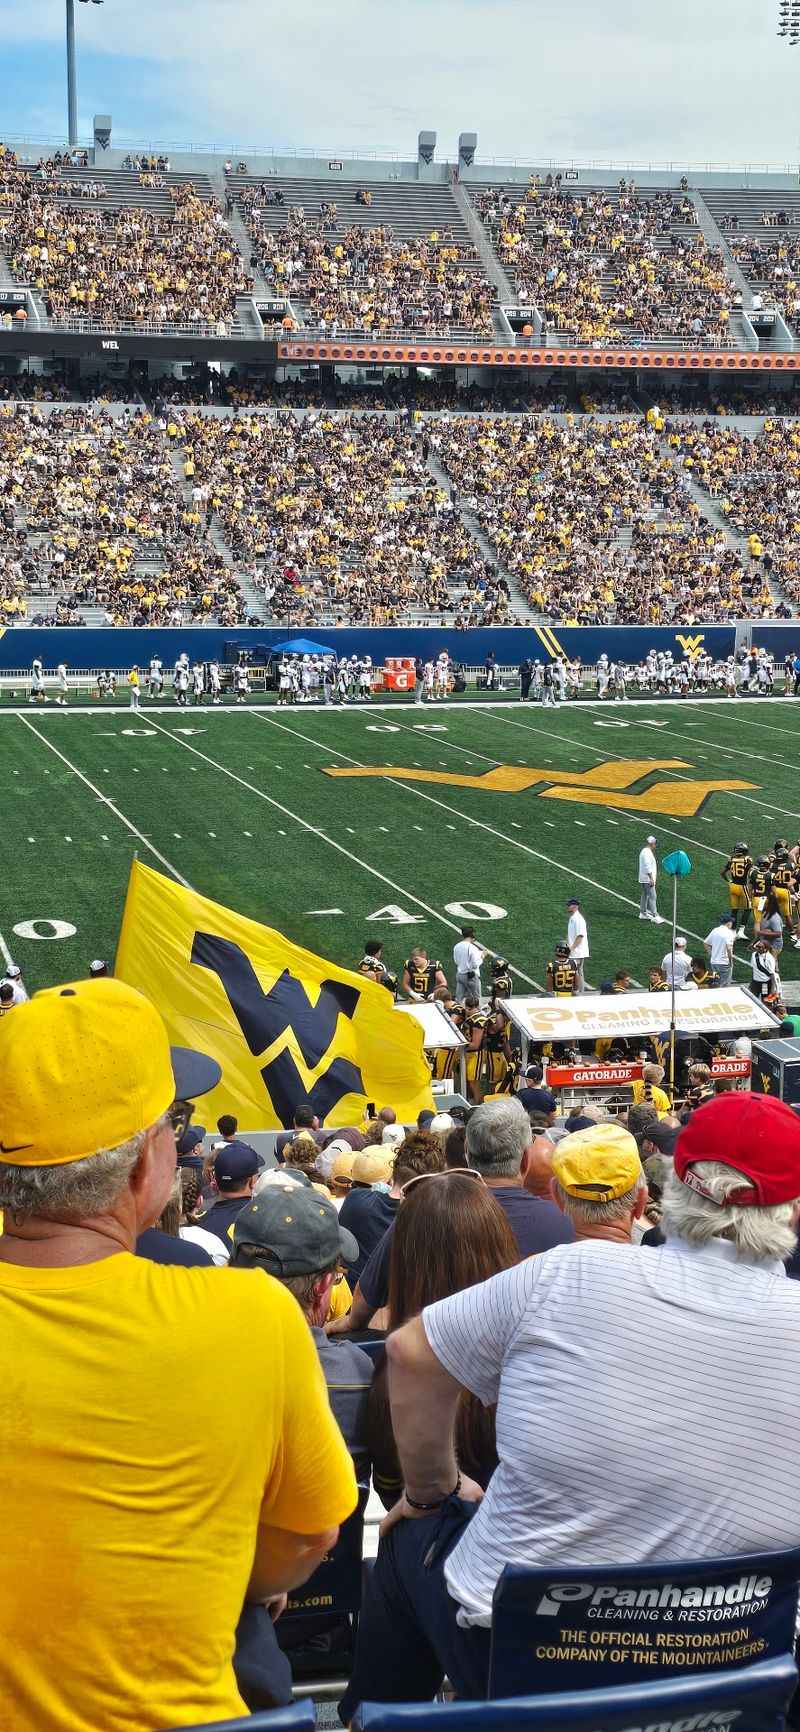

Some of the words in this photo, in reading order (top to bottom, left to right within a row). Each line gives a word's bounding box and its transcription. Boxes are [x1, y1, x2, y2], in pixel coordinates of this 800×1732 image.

[102, 341, 119, 350] WEL
[730, 862, 745, 877] 46
[774, 870, 791, 884] 40
[755, 879, 766, 893] 3
[414, 977, 429, 993] 51
[555, 970, 575, 988] 85
[575, 1003, 753, 1022] Panhandle
[582, 1019, 650, 1031] CLEANING
[573, 1069, 632, 1081] GATORADE
[711, 1063, 748, 1073] ORADE
[590, 1575, 773, 1608] Panhandle
[587, 1607, 660, 1621] CLEANING
[663, 1610, 674, 1622] &
[678, 1598, 769, 1622] RESTORATION
[560, 1629, 587, 1644] THE
[590, 1631, 652, 1646] OFFICIAL
[656, 1627, 750, 1648] RESTORATION
[536, 1646, 608, 1663] COMPANY
[610, 1650, 630, 1664] OF
[632, 1651, 659, 1665] THE
